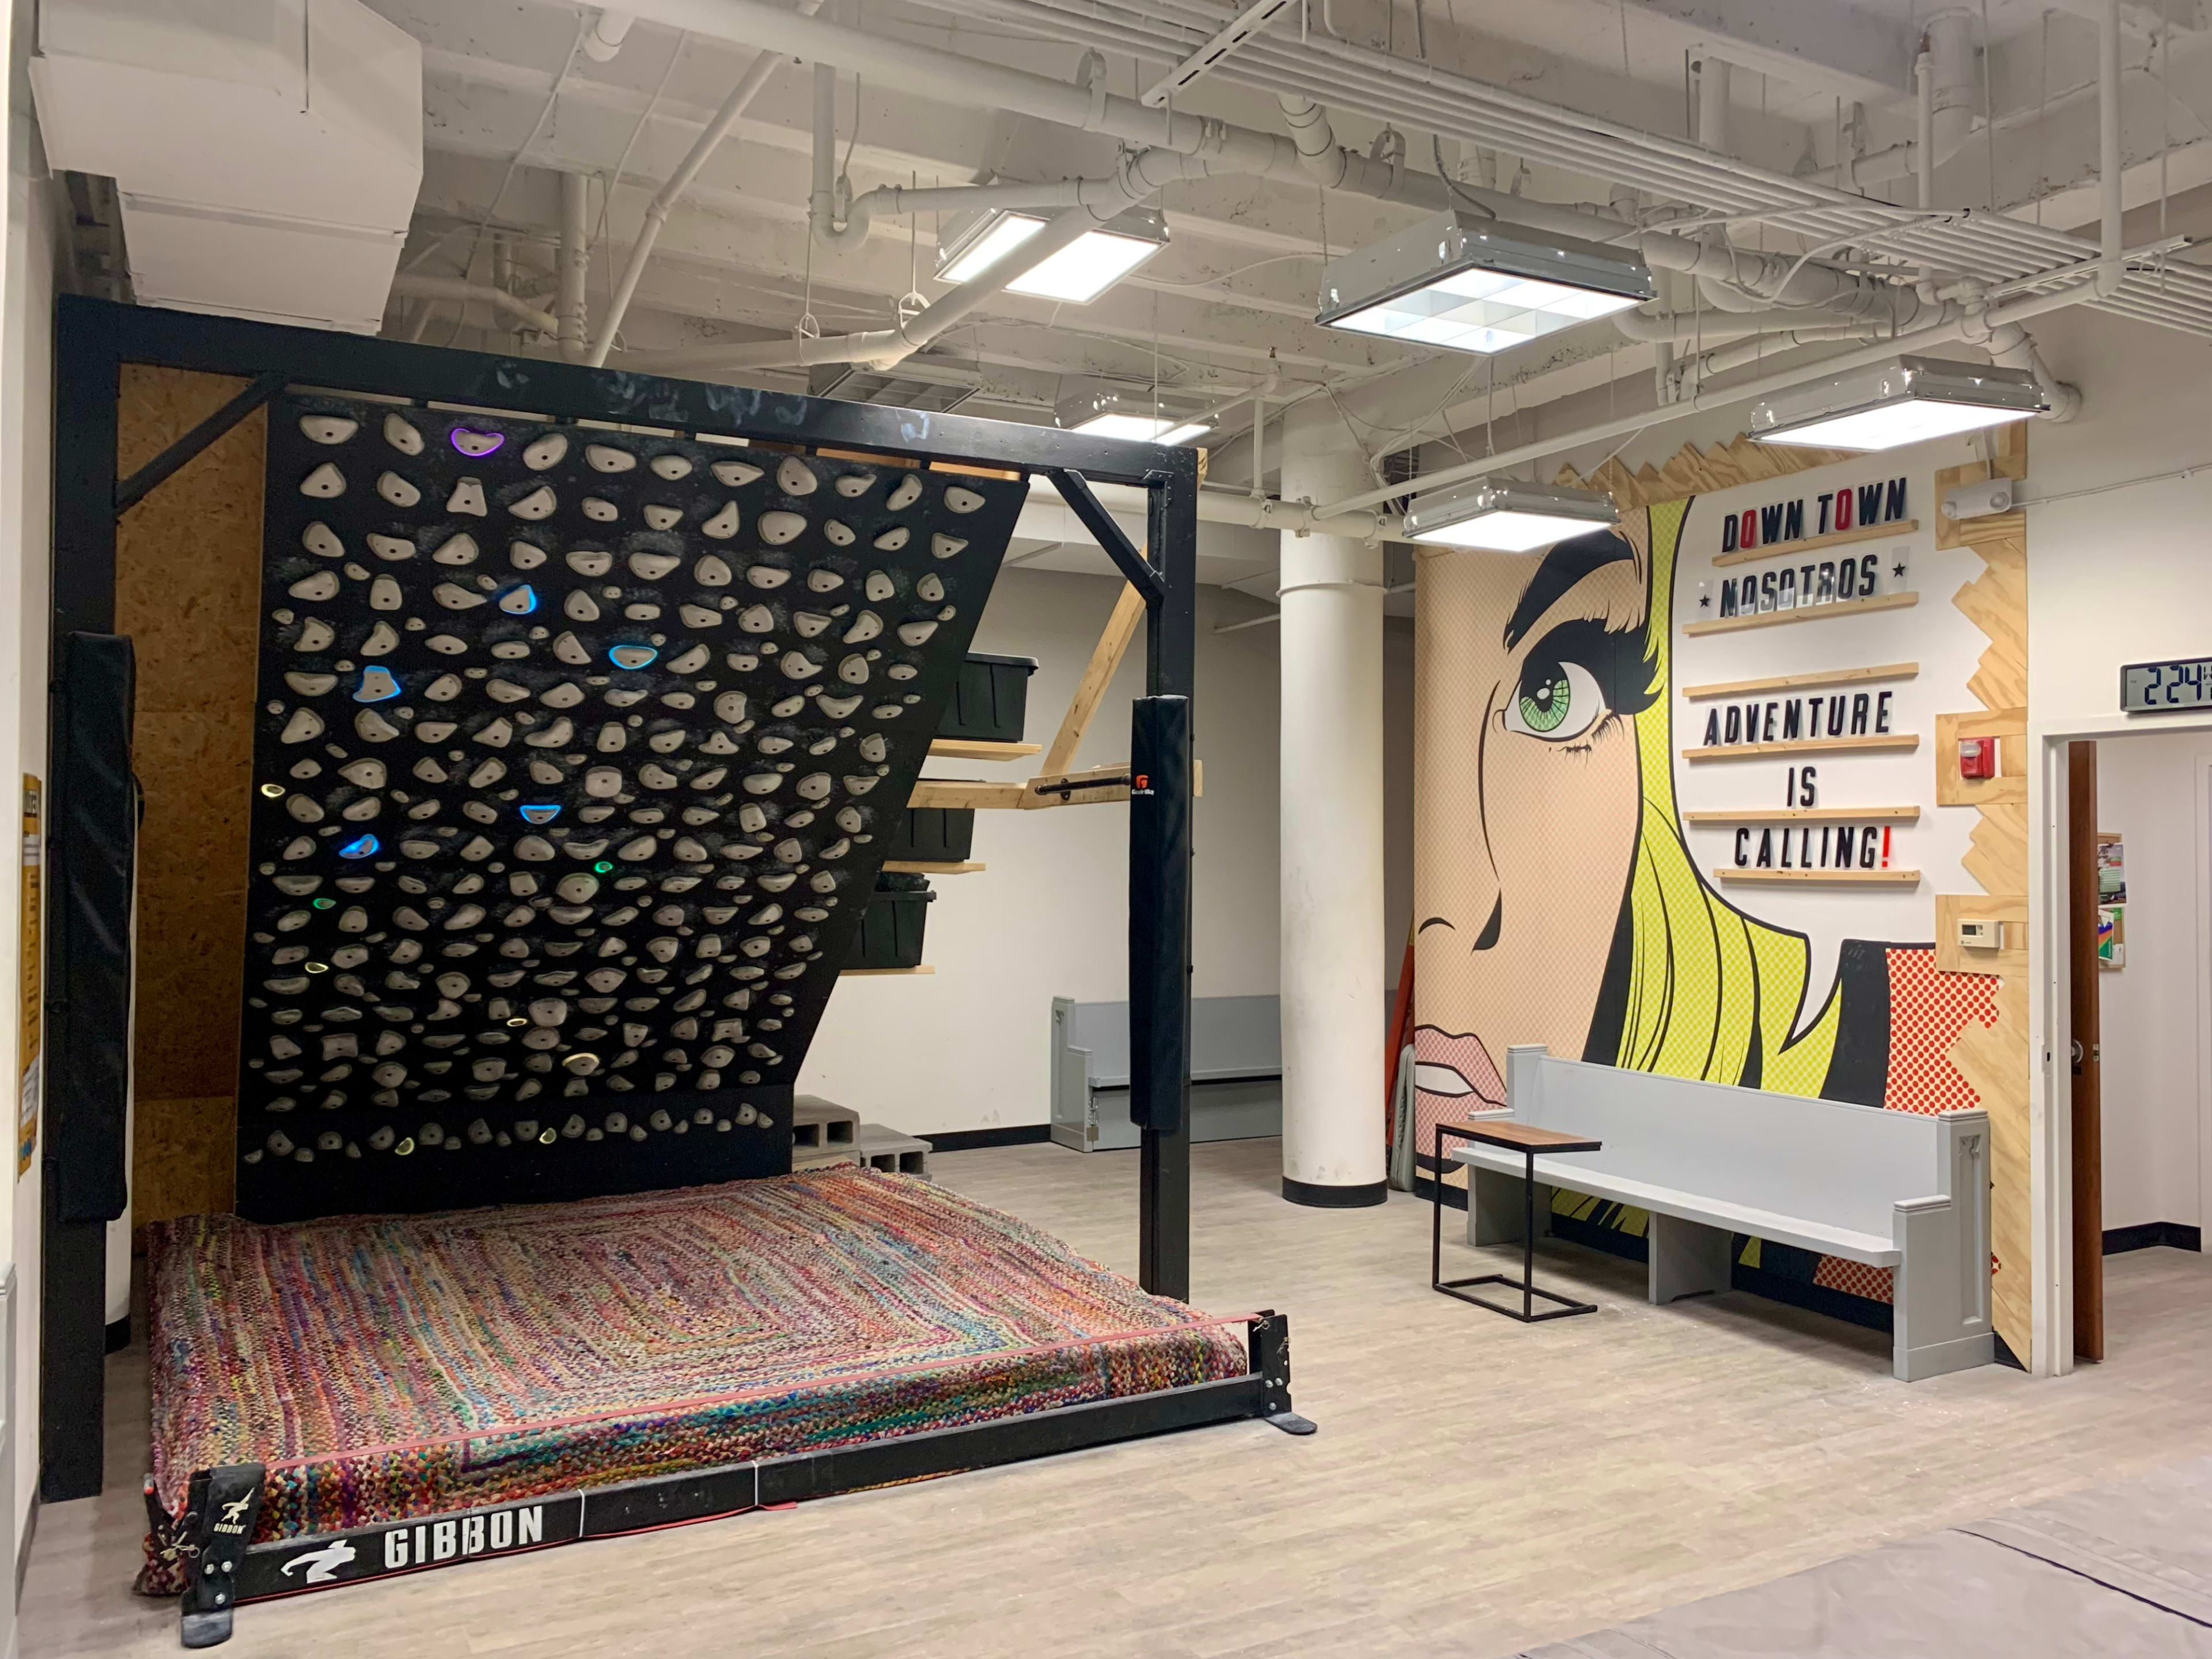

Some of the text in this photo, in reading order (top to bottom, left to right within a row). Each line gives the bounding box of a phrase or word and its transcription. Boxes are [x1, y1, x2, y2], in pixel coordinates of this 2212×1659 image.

[1722, 478, 1906, 553] DOWN TOWN
[1719, 554, 1878, 618] NOSOTROS
[1703, 691, 1893, 746] ADVENTURE
[1787, 766, 1817, 806] IS
[1734, 826, 1890, 868] CALLING!
[214, 1523, 244, 1534] GIBBON
[384, 1506, 544, 1569] GIBBON
